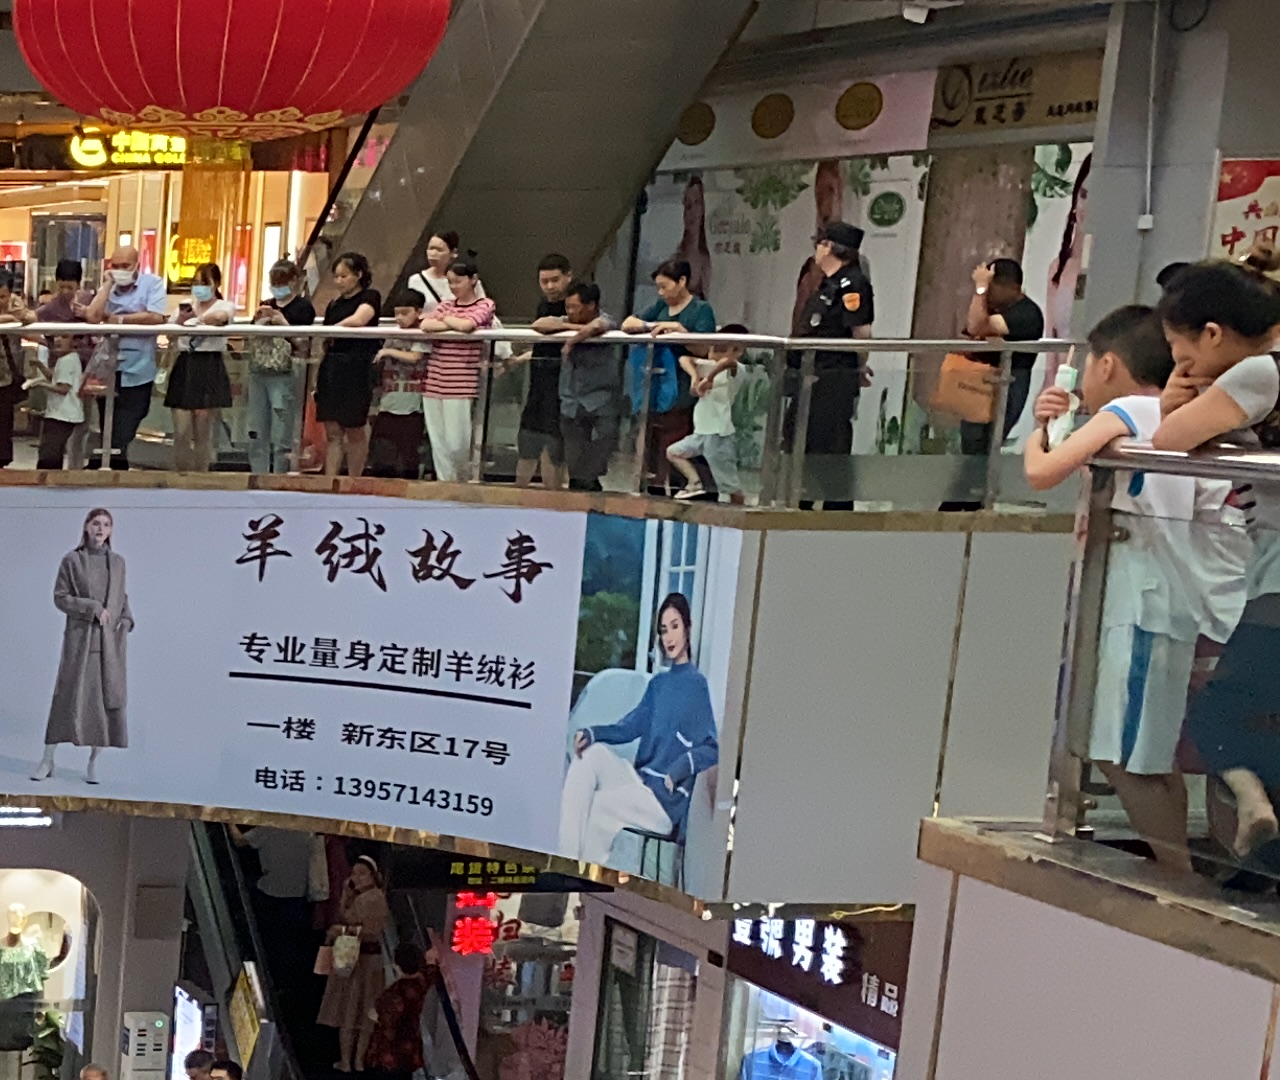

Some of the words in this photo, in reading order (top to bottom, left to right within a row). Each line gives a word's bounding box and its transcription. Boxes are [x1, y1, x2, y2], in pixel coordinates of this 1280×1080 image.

[111, 152, 151, 164] CHINA
[235, 512, 554, 604] 羊绒故事
[238, 632, 536, 690] 专业量身定制羊绒衫
[247, 716, 316, 741] 一楼
[341, 722, 511, 766] 新东区17号
[255, 766, 494, 817] 电话：13957143159
[860, 972, 899, 1018] 精品
